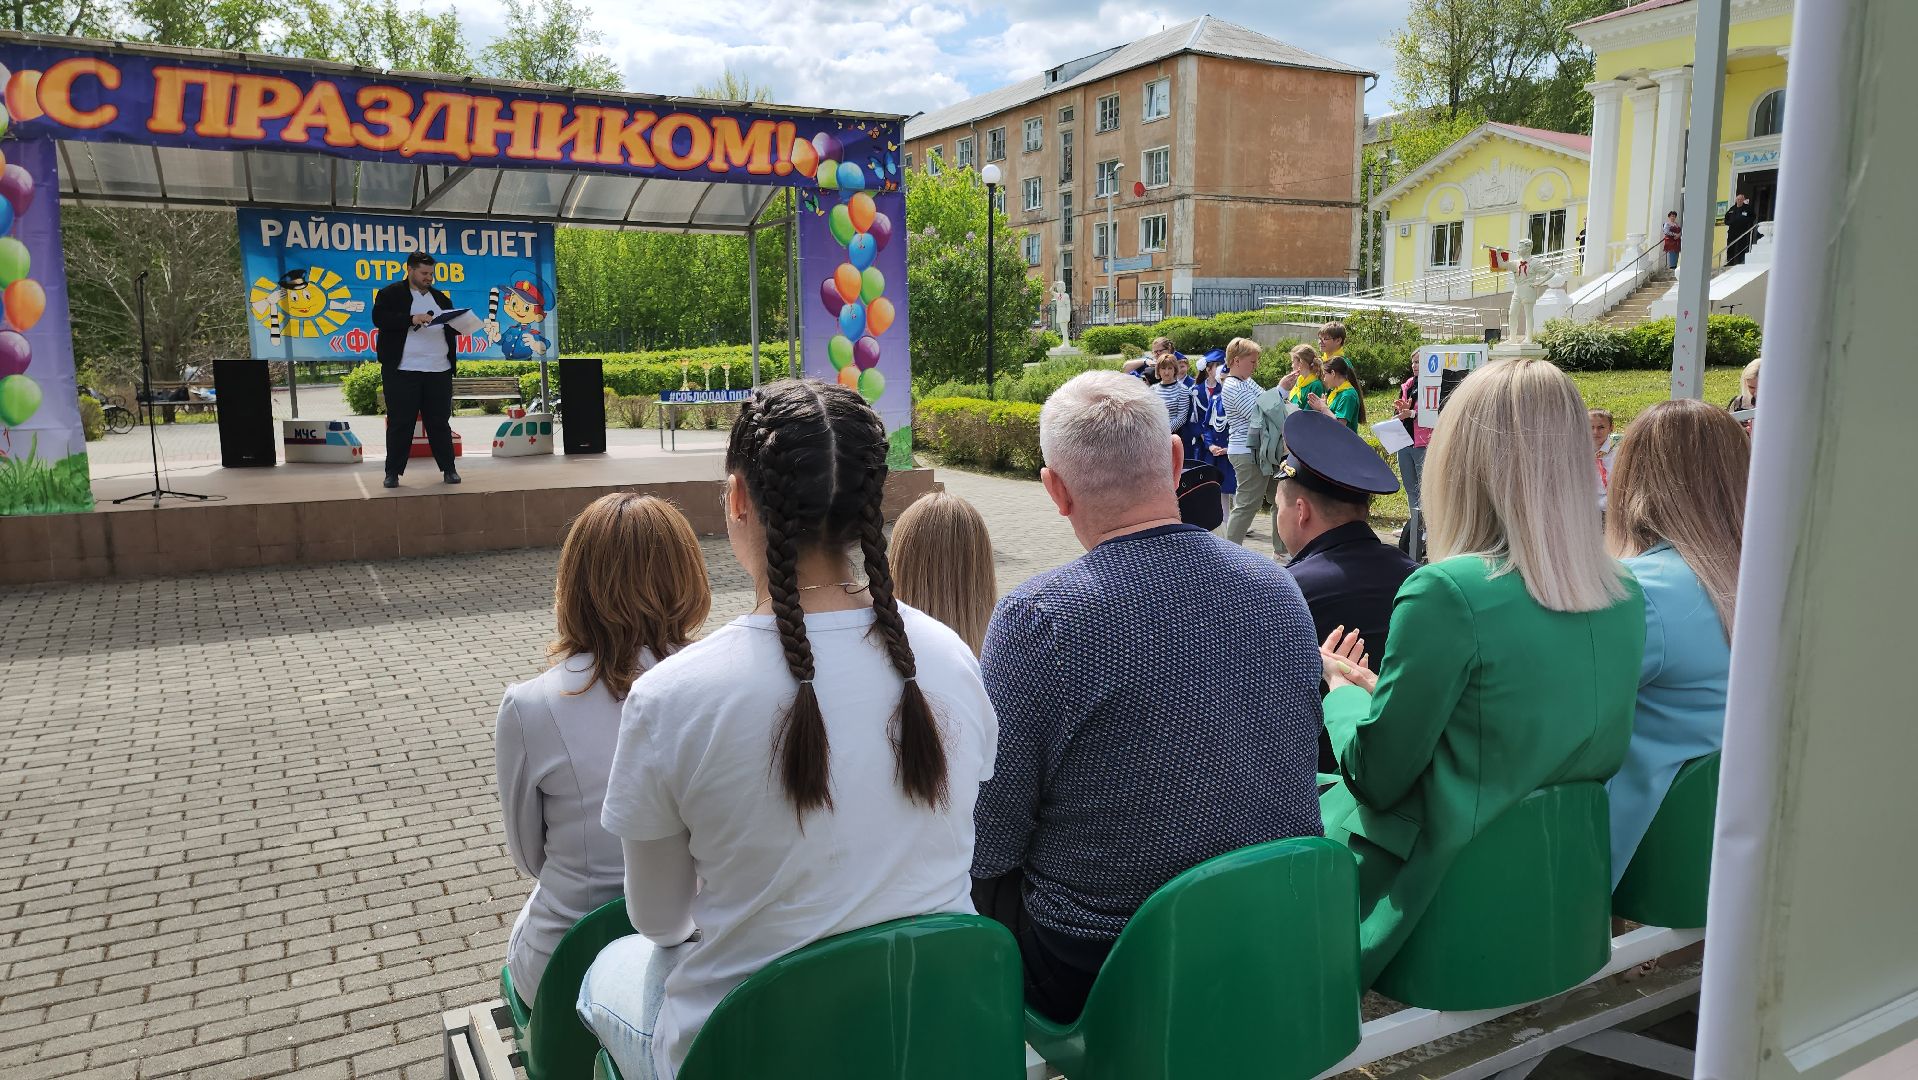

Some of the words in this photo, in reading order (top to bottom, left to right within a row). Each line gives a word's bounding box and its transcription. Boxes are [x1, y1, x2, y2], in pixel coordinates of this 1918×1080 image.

[36, 57, 122, 129] С
[146, 66, 796, 177] ПРАЗДНИКОМ!
[260, 215, 448, 254] РАЙОННЫЙ
[460, 229, 538, 258] СЛЕТ
[355, 259, 465, 284] ОТРОВ
[669, 390, 727, 402] #СОБЛЮДАЙ
[294, 428, 317, 439] МЧС
